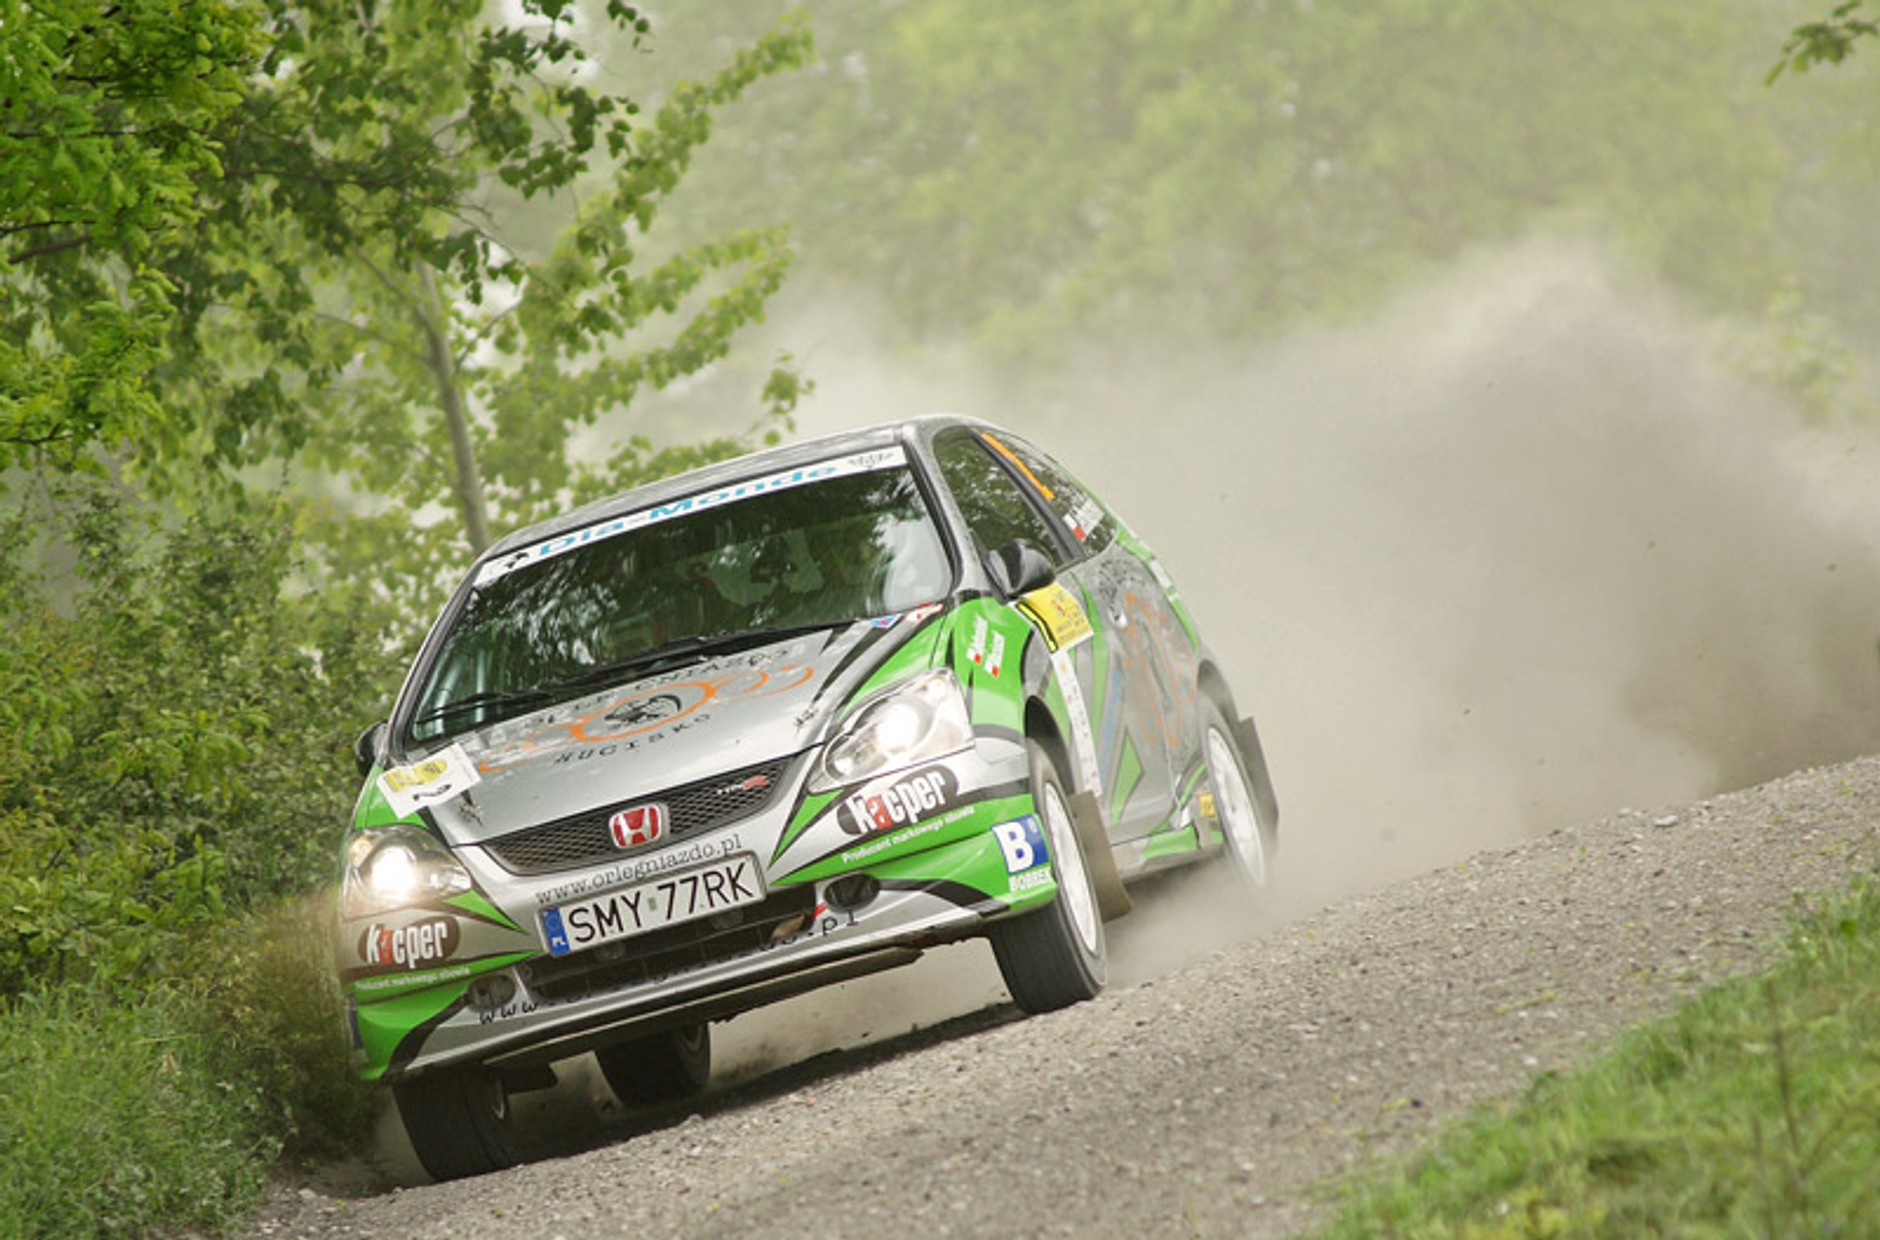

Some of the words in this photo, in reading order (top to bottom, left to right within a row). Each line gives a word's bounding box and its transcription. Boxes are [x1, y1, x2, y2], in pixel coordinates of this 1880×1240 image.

[536, 833, 742, 903] www.orlegniazdo.pl
[568, 890, 641, 942] SMY
[657, 862, 754, 920] 77RK
